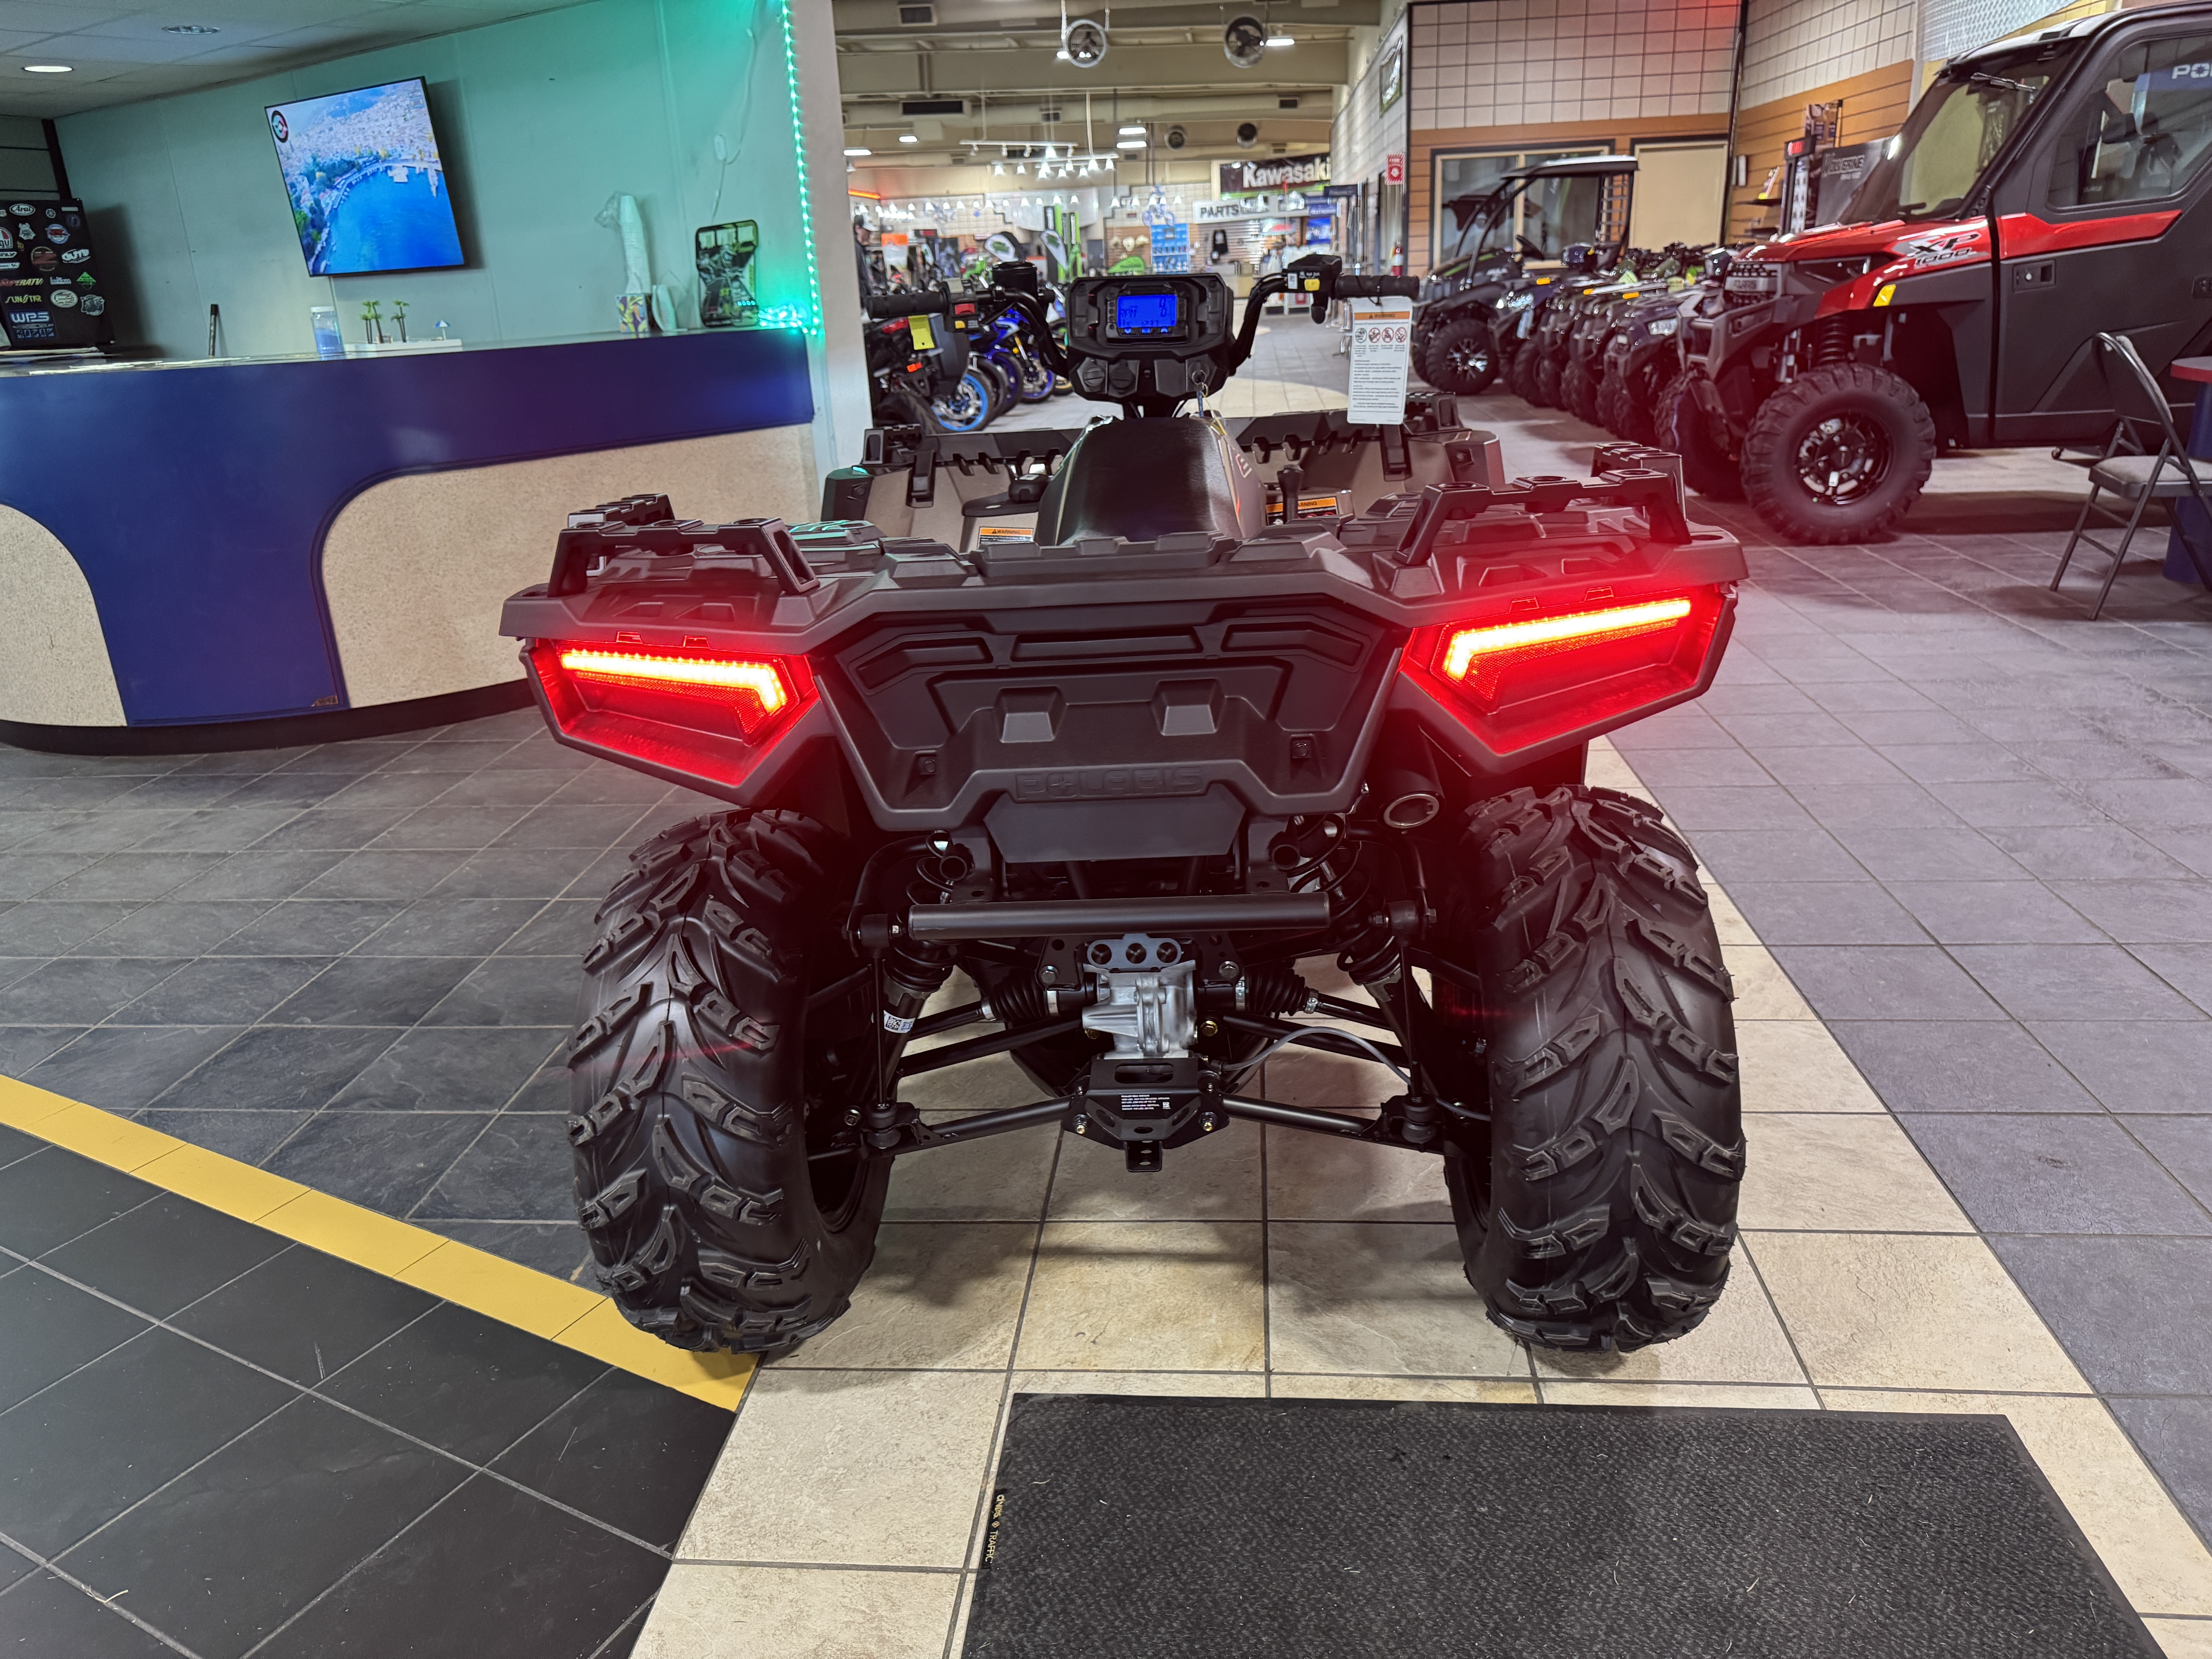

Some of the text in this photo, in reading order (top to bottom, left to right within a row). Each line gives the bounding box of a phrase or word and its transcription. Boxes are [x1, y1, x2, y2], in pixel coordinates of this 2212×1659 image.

[2172, 63, 2212, 79] PO
[1243, 157, 1331, 188] Kawasaki
[1200, 204, 1239, 218] PARTS
[1907, 232, 1981, 256] XP
[11, 312, 50, 323] WPS
[1015, 766, 1202, 800] POLARIS
[985, 1530, 998, 1562] TRAFFIC
